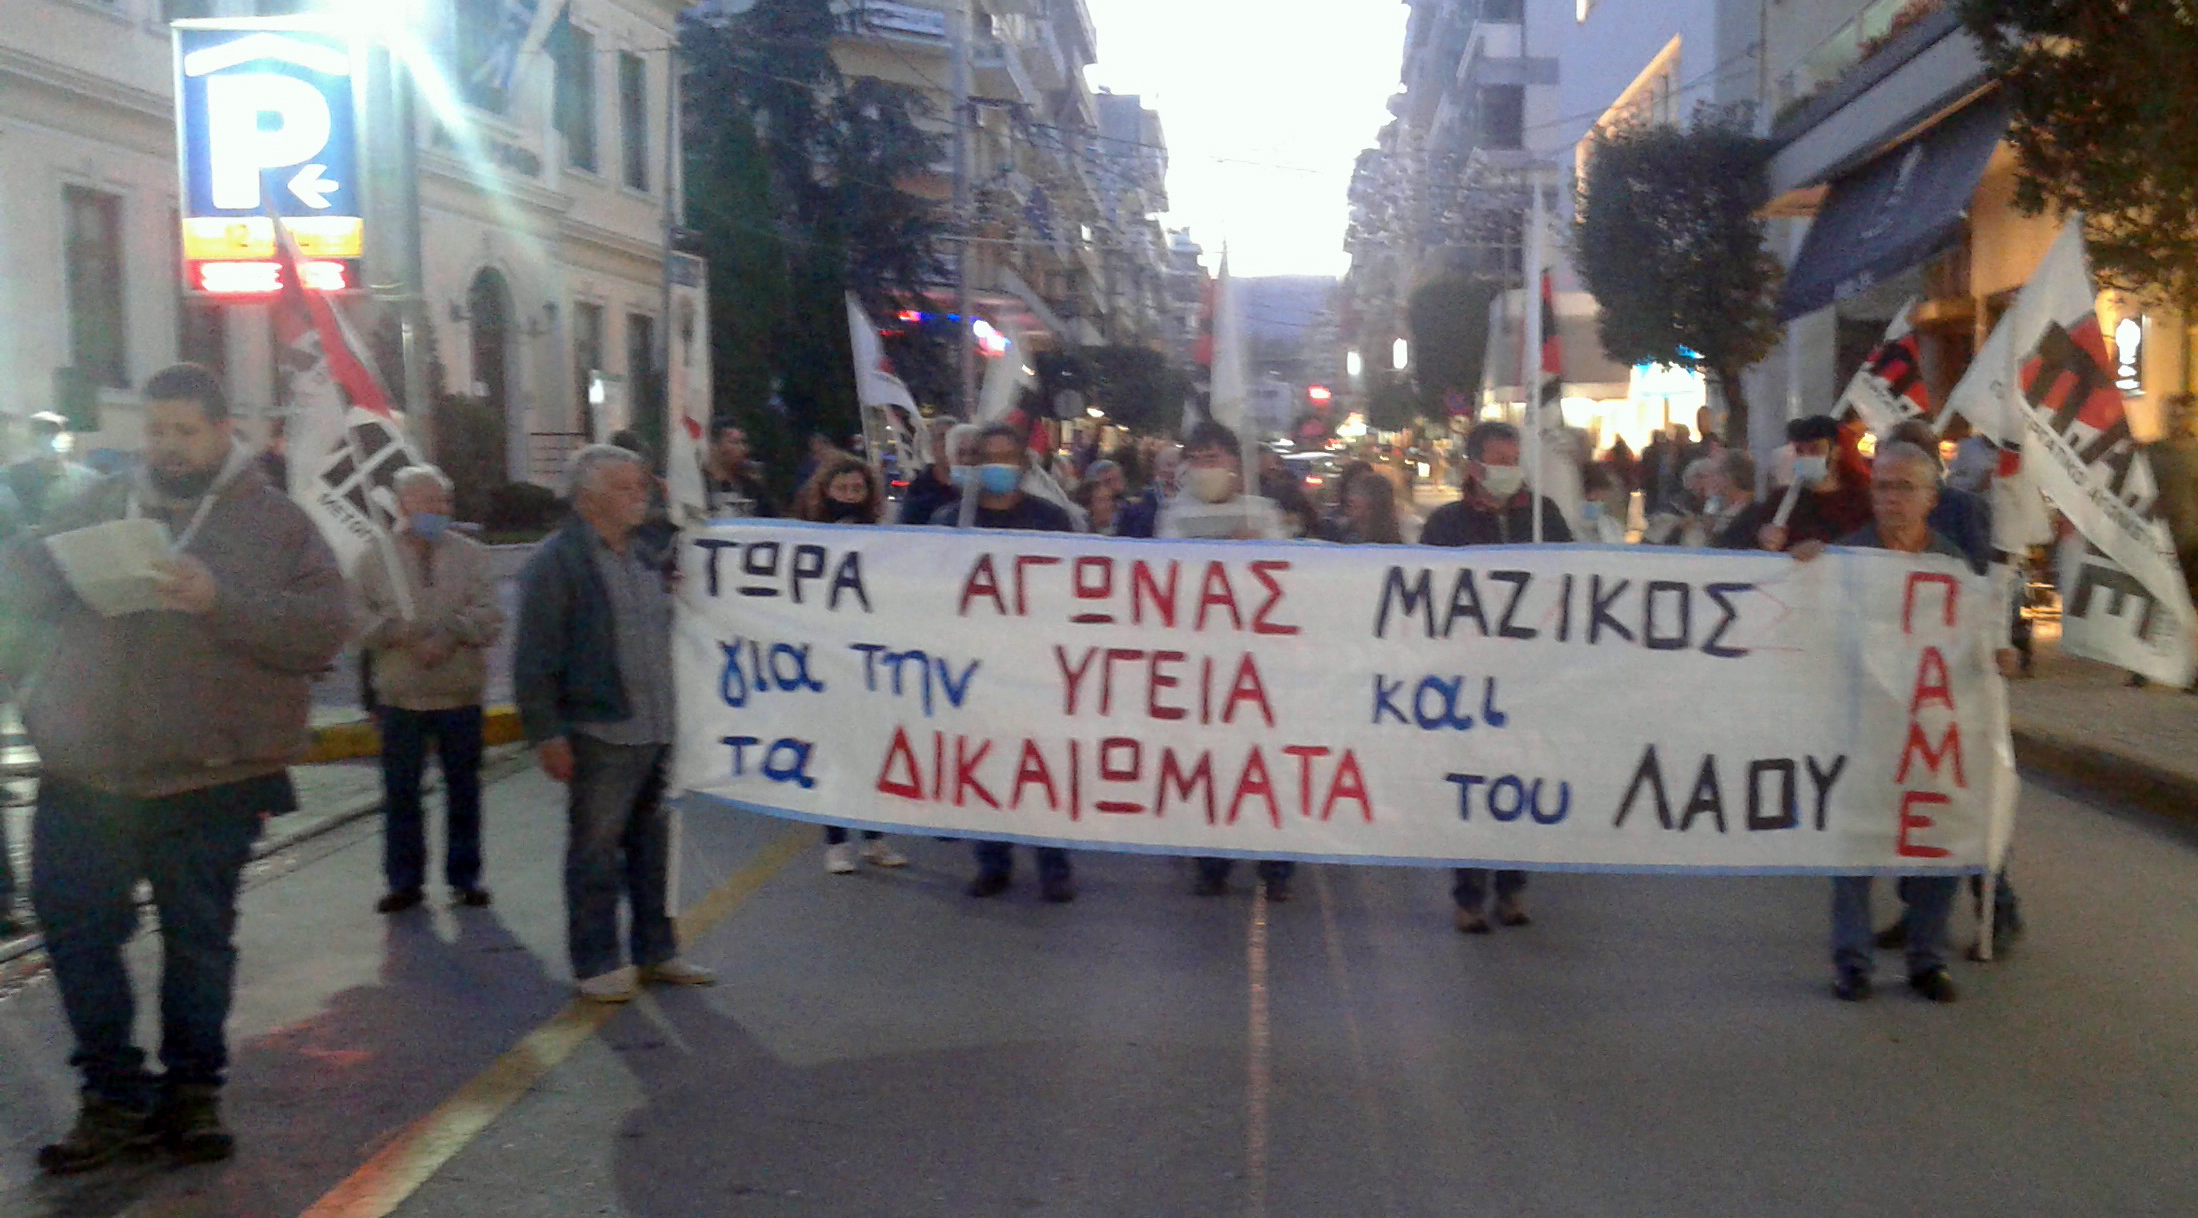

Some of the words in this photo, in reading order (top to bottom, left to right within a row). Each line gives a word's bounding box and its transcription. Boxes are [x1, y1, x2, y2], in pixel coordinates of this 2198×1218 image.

[207, 73, 331, 209] P
[694, 537, 872, 614] ΤΩΡΑ
[957, 552, 1301, 634] ΑΓΩΝΑΣ
[1374, 565, 1755, 658] ΜΑΖΙΚΟΣ
[717, 635, 825, 709] για
[849, 641, 981, 717] την
[1055, 643, 1275, 727] ΥΓΕΙΑ
[1371, 673, 1507, 730] και
[1895, 570, 1967, 858] ΠΑΜΕ
[719, 734, 817, 789] τα
[876, 723, 1374, 829] ΔΙΚΑΙΩΜΑΤΑ
[1443, 771, 1572, 825] του
[1612, 743, 1849, 833] ΛΑΟΥ
